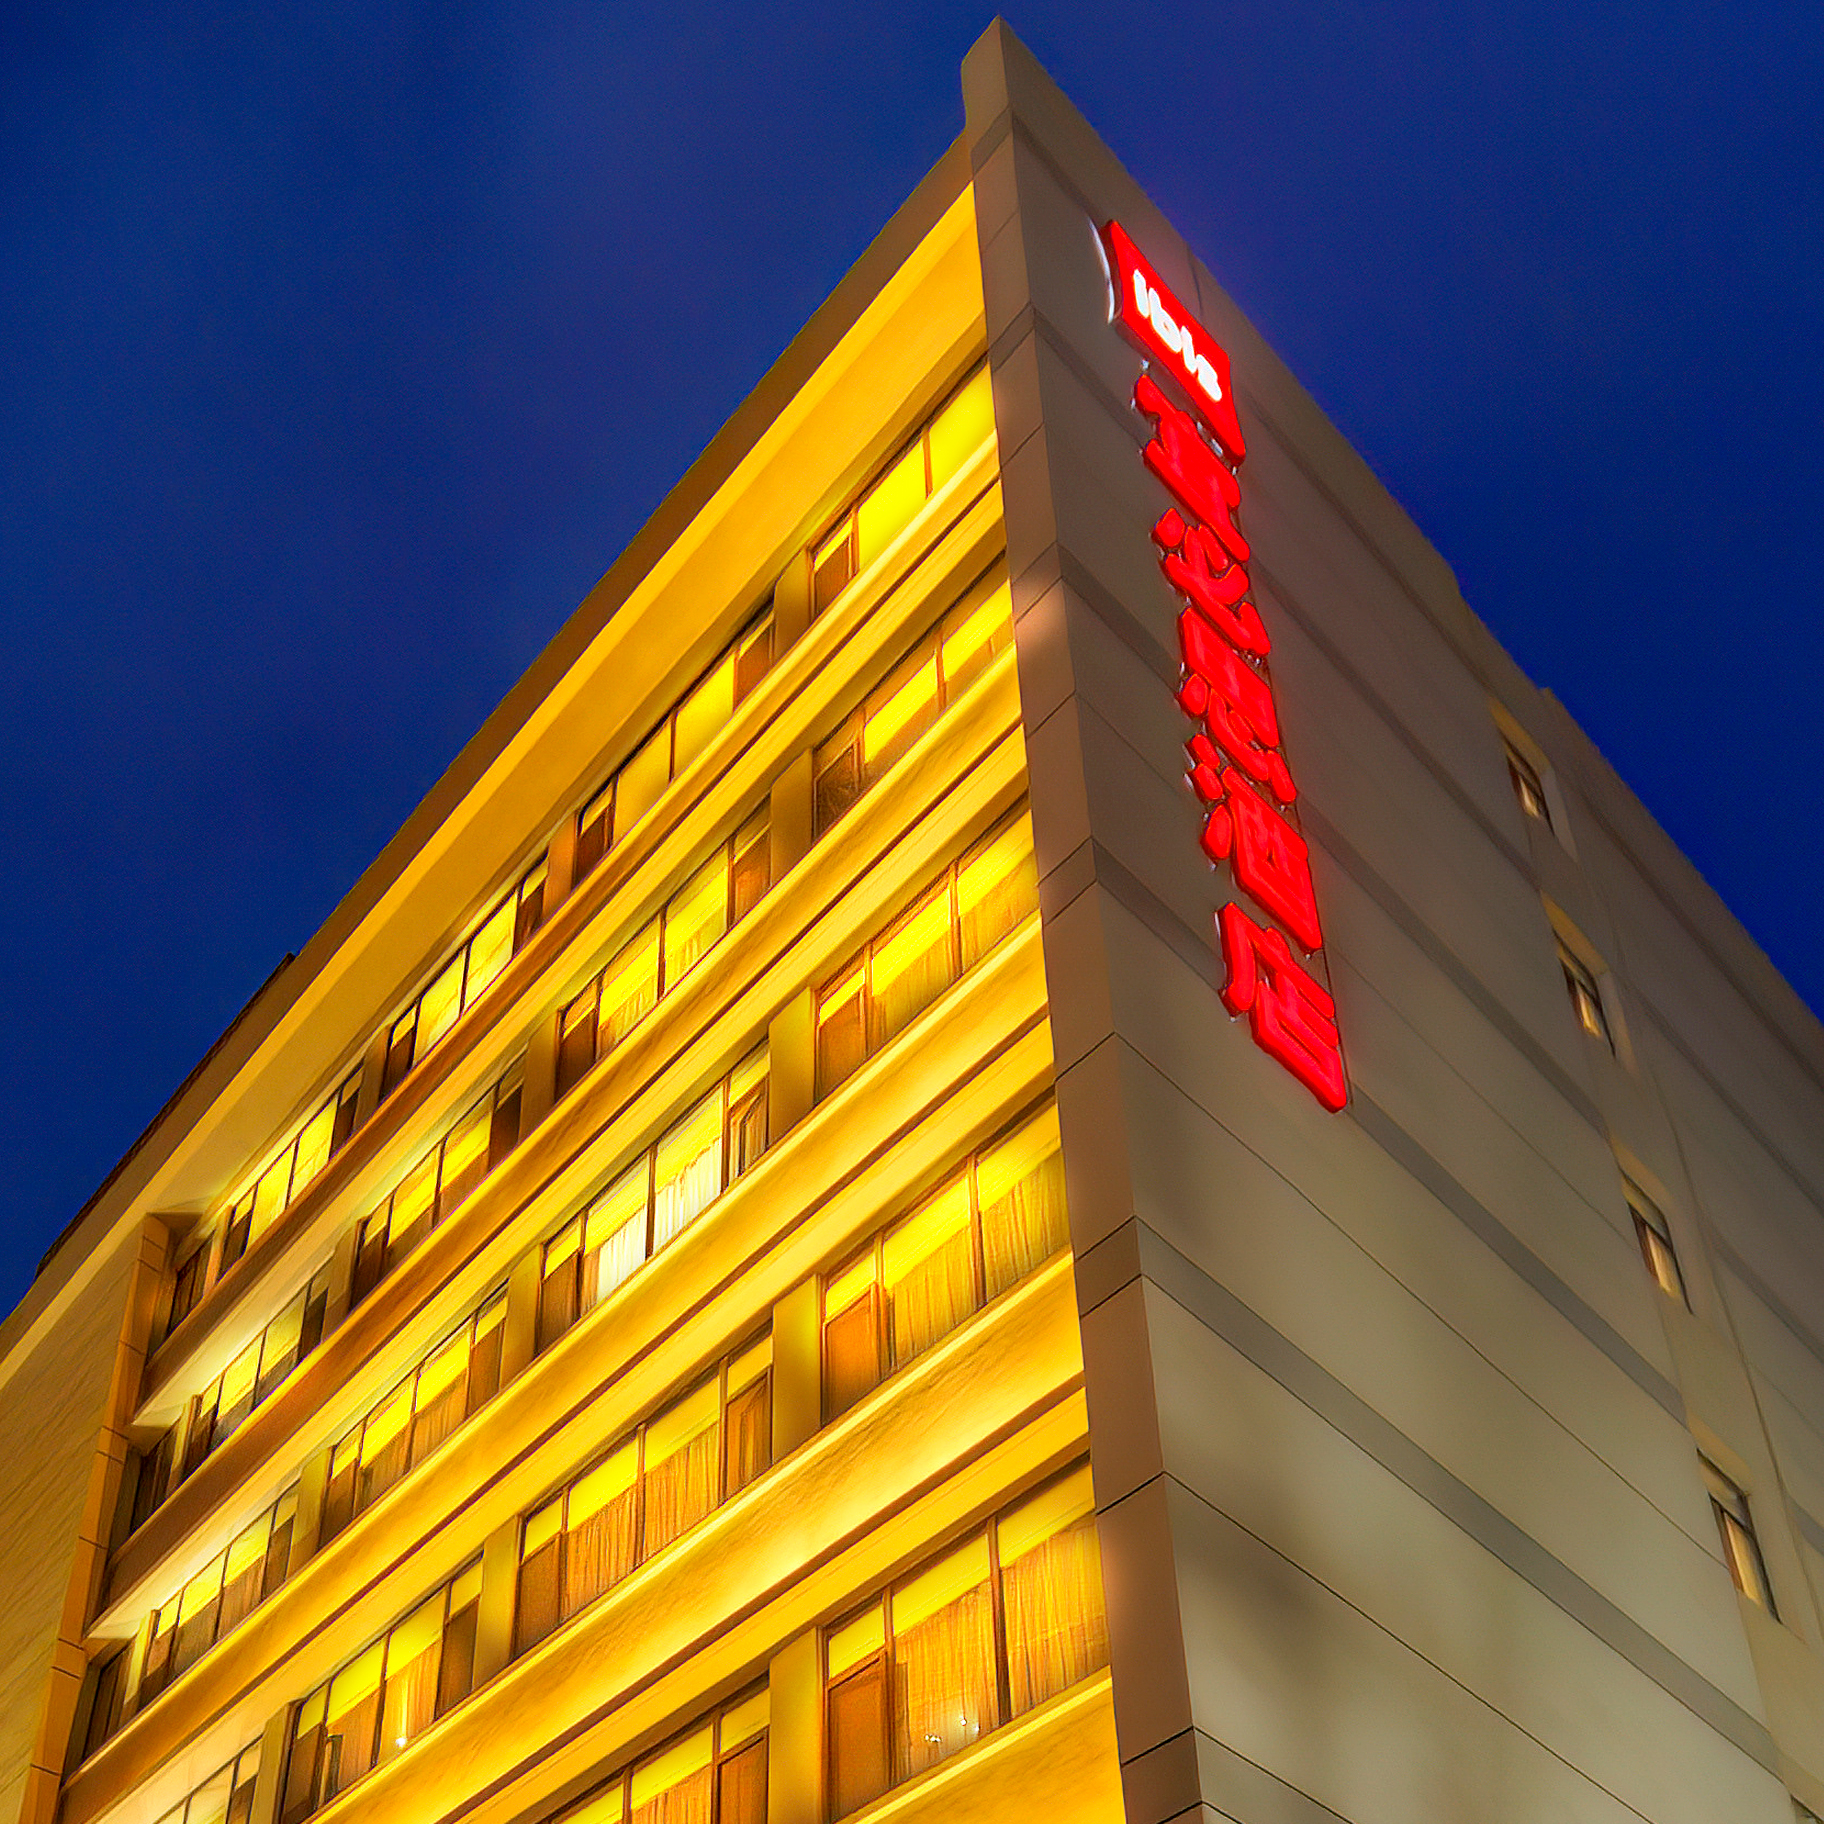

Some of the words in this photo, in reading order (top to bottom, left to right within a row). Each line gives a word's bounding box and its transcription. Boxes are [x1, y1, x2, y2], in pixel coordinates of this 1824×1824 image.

[1133, 268, 1223, 402] ibis
[1130, 372, 1350, 1114] 宜必思酒店
